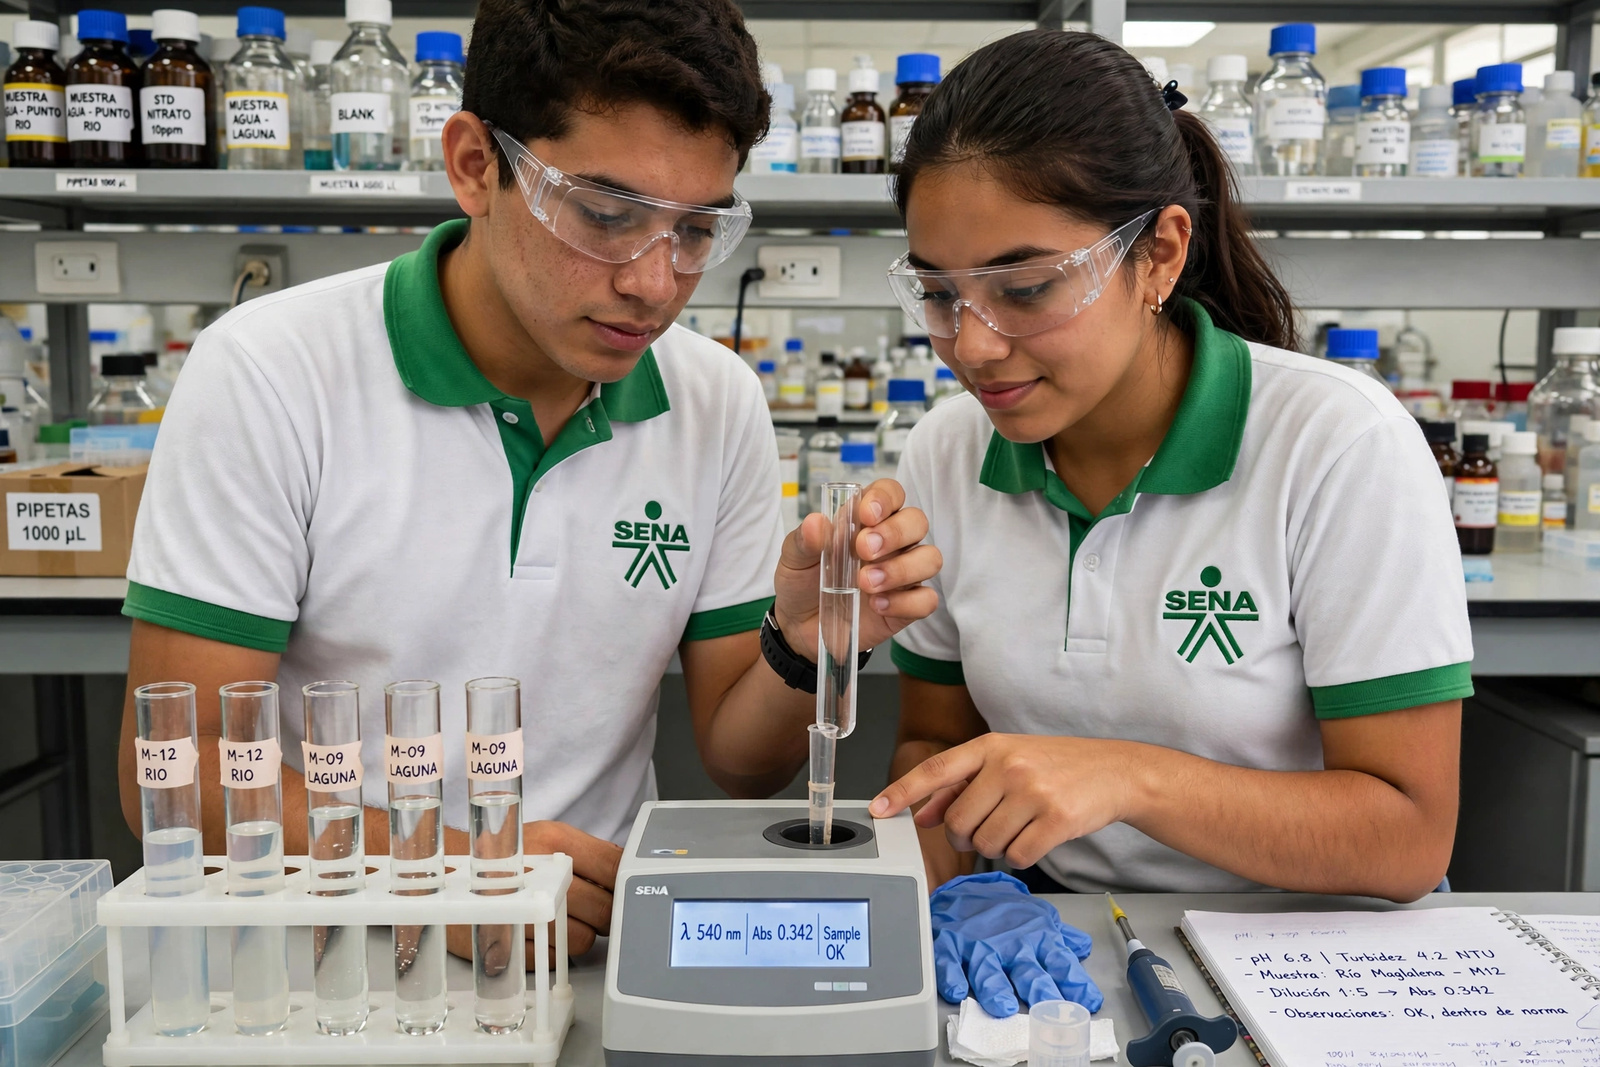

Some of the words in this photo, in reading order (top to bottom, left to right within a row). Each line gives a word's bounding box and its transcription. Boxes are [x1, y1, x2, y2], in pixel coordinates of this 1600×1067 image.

[70, 92, 117, 103] MUESTRA
[154, 94, 175, 105] STD
[229, 99, 278, 110] MUESTRA
[26, 105, 61, 118] PUNTO
[95, 107, 131, 119] PUNTO
[147, 108, 191, 120] NITRATO
[338, 108, 375, 120] BLANK
[15, 119, 31, 130] RIO
[233, 113, 261, 125] AGUA
[84, 121, 101, 131] RIO
[152, 125, 183, 137] 10ppm
[232, 128, 276, 139] LAGUNA
[16, 502, 90, 519] PIPETAS
[22, 525, 60, 541] 1000
[65, 525, 86, 545] µL
[614, 520, 689, 544] SENA
[1165, 590, 1258, 612] SENA
[141, 748, 177, 761] M-12
[227, 748, 264, 761] M-12
[390, 745, 425, 758] M-09
[471, 741, 506, 755] M-09
[309, 752, 344, 765] M-09
[390, 764, 438, 777] LAGUNA
[471, 760, 518, 774] LAGUNA
[145, 768, 167, 781] RIO
[231, 769, 254, 782] RIO
[308, 771, 357, 784] LAGUNA
[635, 885, 669, 896] SENA
[680, 922, 691, 941] λ
[696, 923, 722, 941] 540
[725, 930, 741, 941] nm
[752, 925, 772, 941] Abs
[777, 924, 813, 941] 0.342
[823, 926, 861, 944] Sample
[826, 944, 845, 961] OK
[1250, 953, 1273, 966] pH
[1284, 953, 1312, 963] 6.8
[1336, 952, 1406, 963] Turbidez
[1417, 951, 1448, 961] 4.2
[1456, 949, 1495, 960] NTU
[1260, 969, 1326, 980] Muestra:
[1335, 968, 1362, 979] Río
[1469, 967, 1506, 976] M12
[1269, 987, 1331, 998] Dilución
[1338, 987, 1369, 998] 1:5
[1408, 986, 1437, 997] Abs
[1443, 985, 1495, 996] 0.342
[1284, 1008, 1395, 1019] Observaciones:
[1404, 1007, 1435, 1020] OK,
[1441, 1007, 1487, 1018] dentro
[1496, 1006, 1514, 1016] de
[1521, 1007, 1569, 1015] norma
